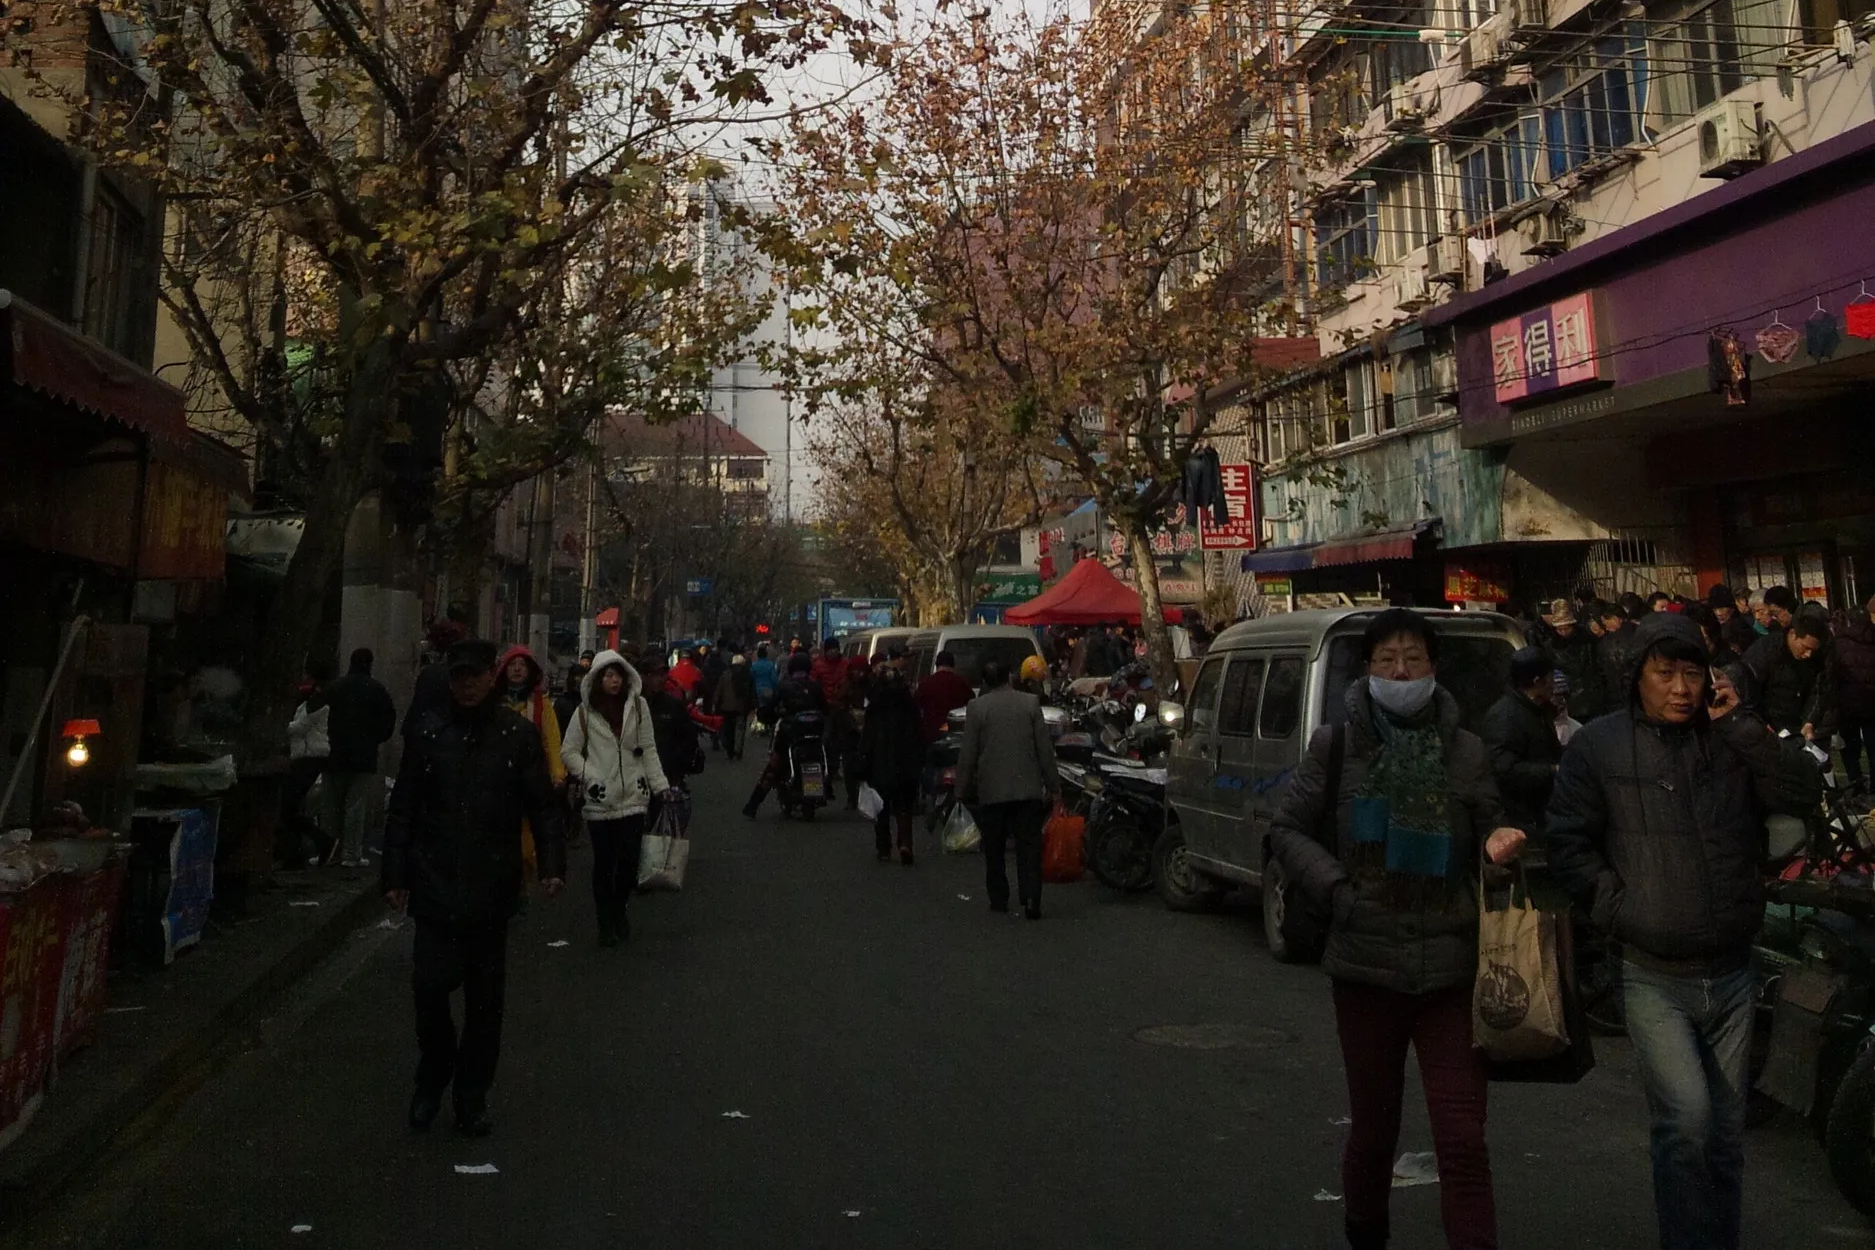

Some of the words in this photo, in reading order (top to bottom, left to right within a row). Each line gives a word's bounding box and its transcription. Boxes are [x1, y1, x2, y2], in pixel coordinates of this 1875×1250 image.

[1494, 307, 1589, 390] 家得利
[1551, 395, 1616, 422] SUPERMARKET
